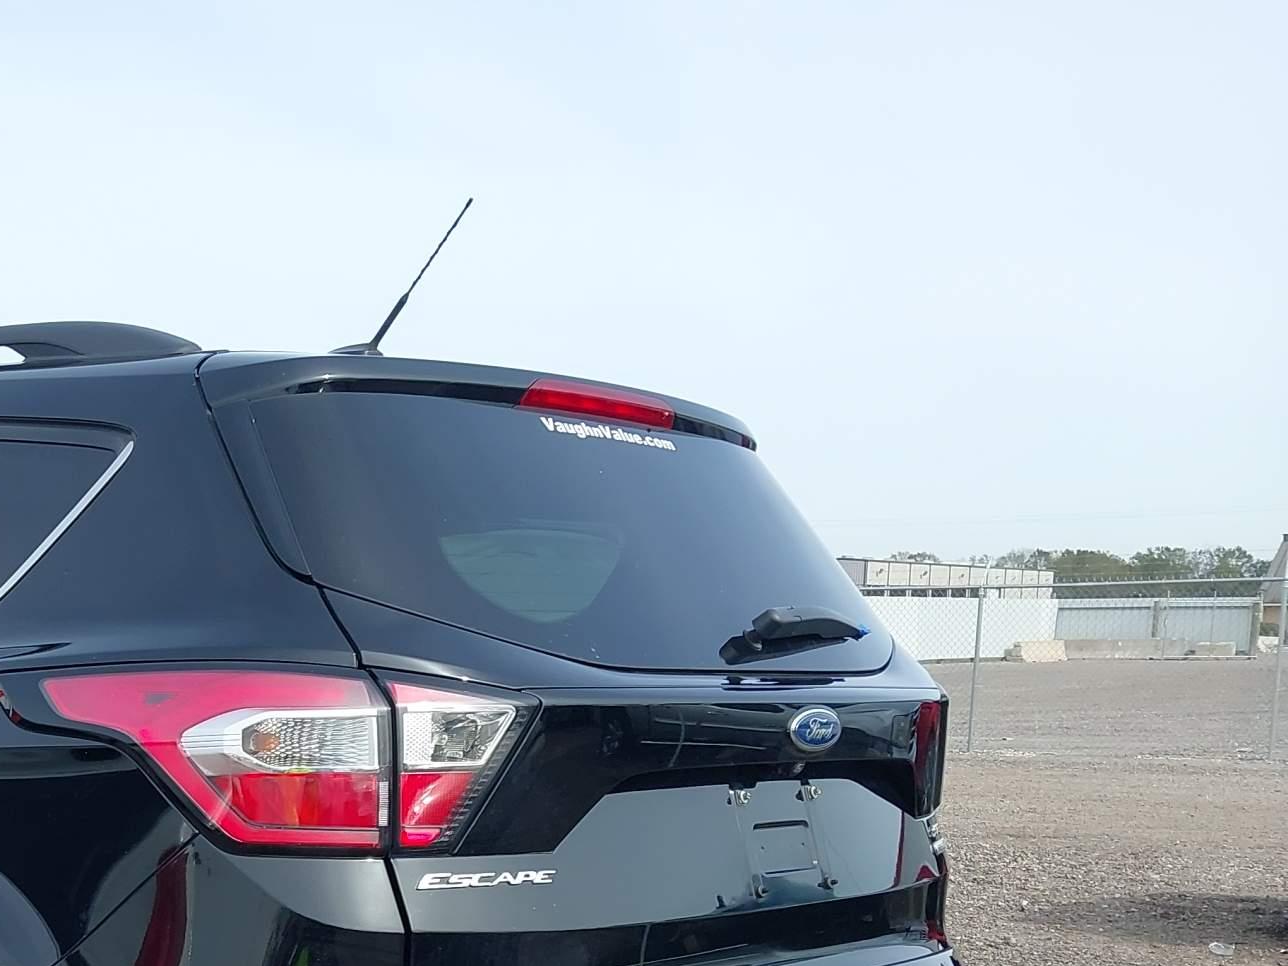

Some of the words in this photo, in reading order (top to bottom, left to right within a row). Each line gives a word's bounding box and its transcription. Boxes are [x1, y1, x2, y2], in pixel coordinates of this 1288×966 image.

[539, 416, 677, 451] VaughnValue.com
[806, 717, 834, 741] Ford
[416, 870, 557, 890] ESCAPE
